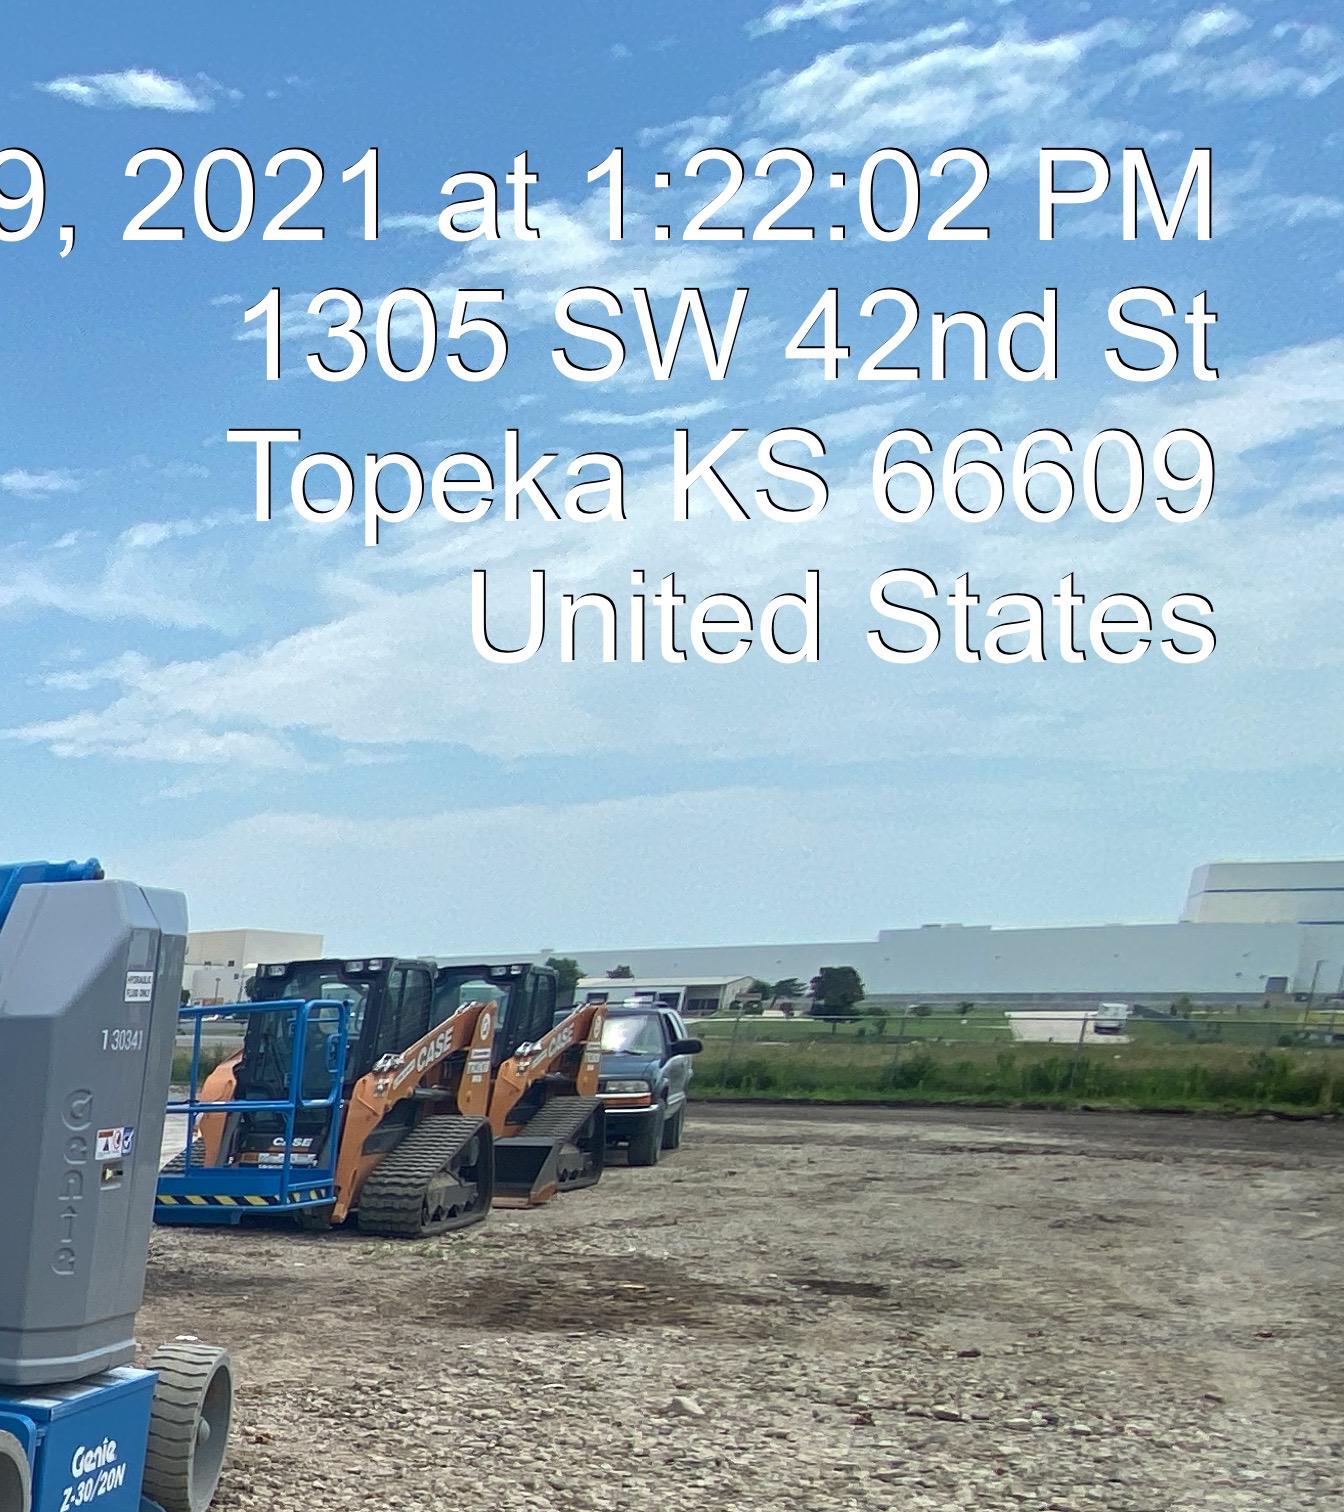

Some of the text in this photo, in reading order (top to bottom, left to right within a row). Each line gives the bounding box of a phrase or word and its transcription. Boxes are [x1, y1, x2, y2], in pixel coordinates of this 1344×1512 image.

[416, 1028, 454, 1072] CASE
[273, 1137, 313, 1147] CSE
[71, 1436, 117, 1478] Genie
[59, 1462, 126, 1512] Z-30/20N
